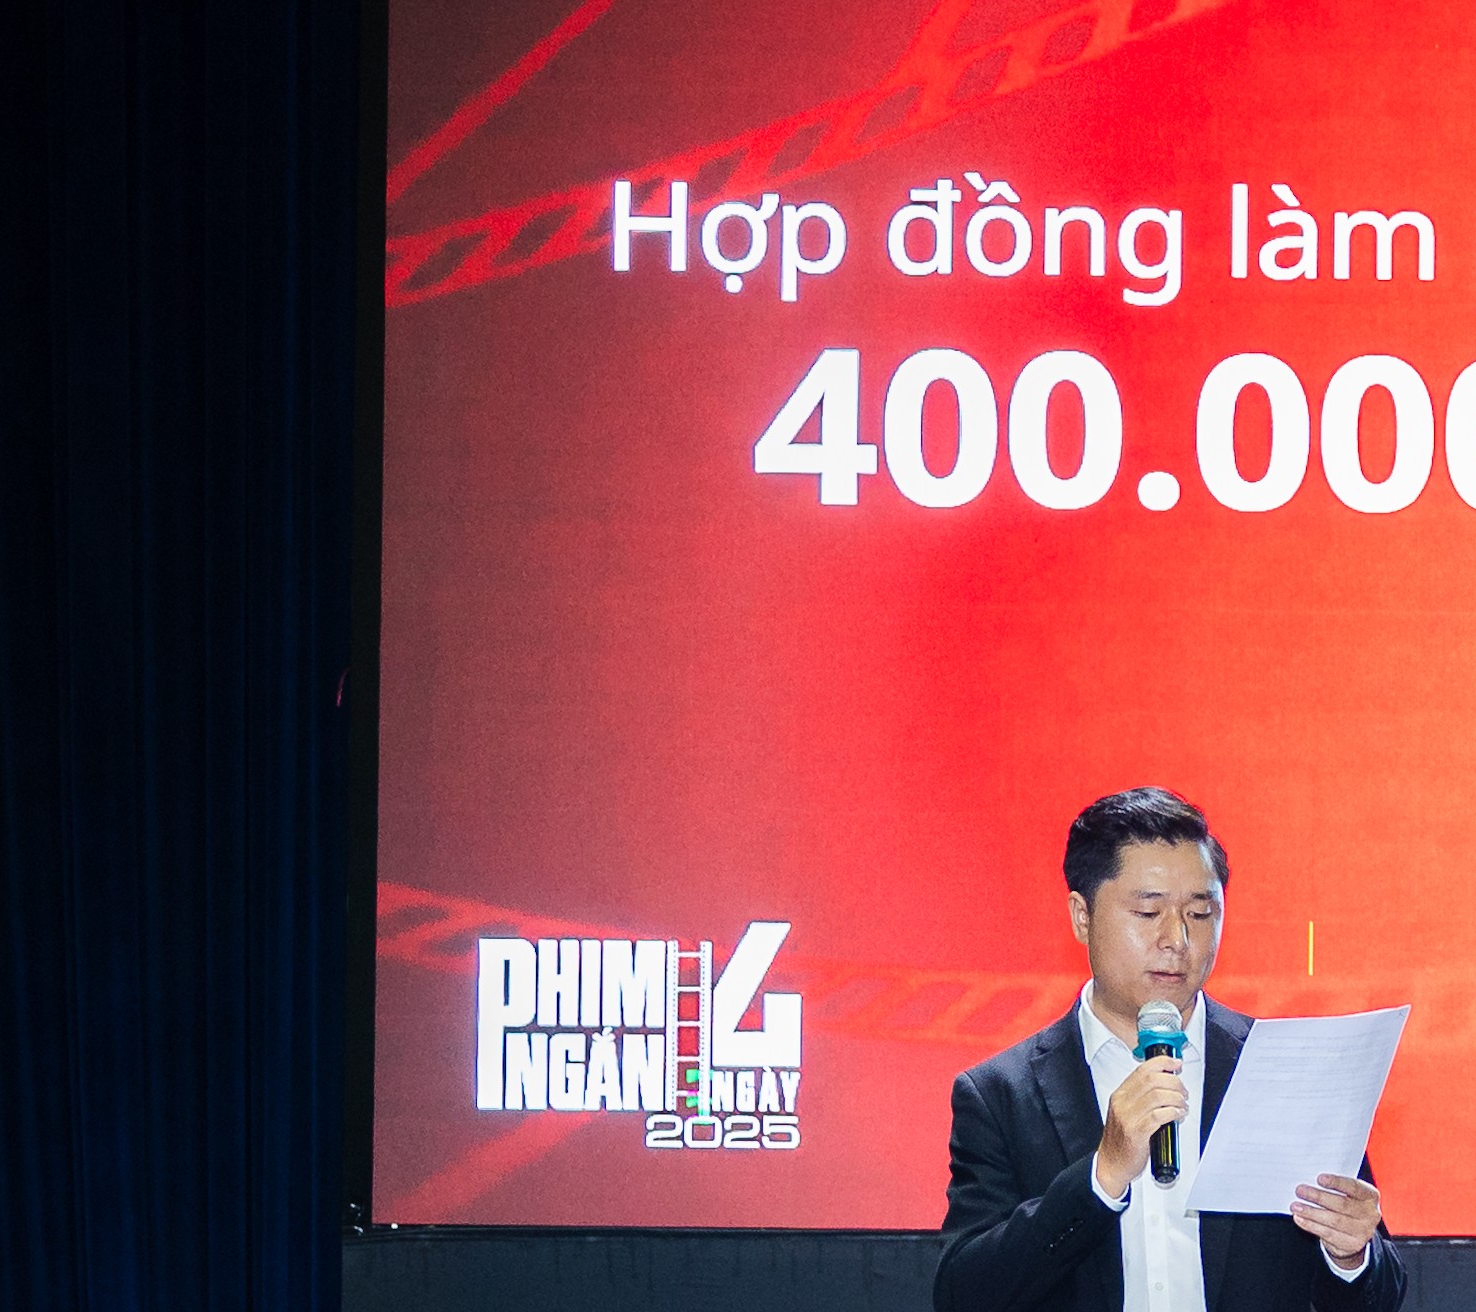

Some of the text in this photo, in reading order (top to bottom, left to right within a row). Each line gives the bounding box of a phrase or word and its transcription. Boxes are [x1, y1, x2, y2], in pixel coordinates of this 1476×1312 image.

[613, 181, 846, 302] Hợp
[888, 172, 1182, 306] đồng
[1232, 184, 1434, 280] làm
[477, 937, 666, 1093] PHIM
[503, 1026, 666, 1111] NGẮN
[711, 1066, 801, 1112] NGÀY
[645, 1115, 800, 1149] 2025
